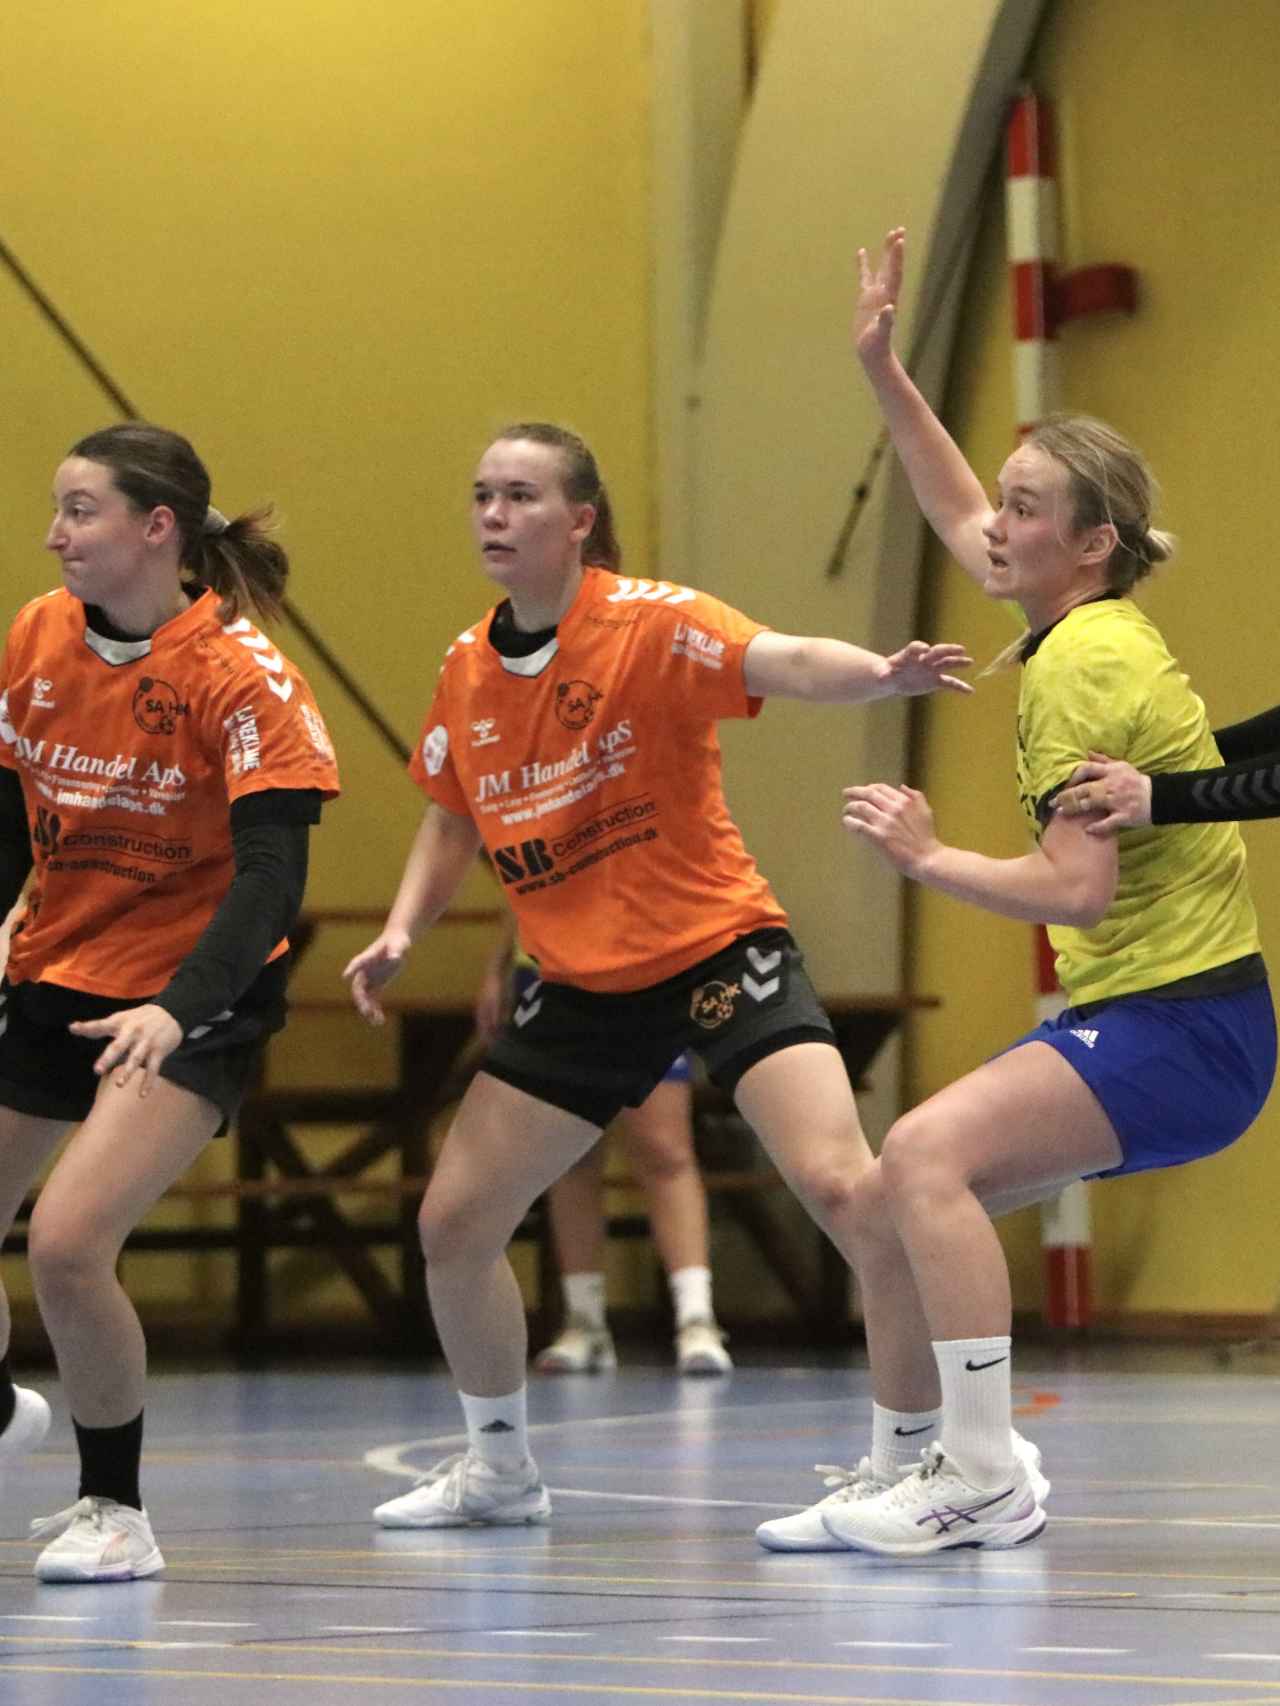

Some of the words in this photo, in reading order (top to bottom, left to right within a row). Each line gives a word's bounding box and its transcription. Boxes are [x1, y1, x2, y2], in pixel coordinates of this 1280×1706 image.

[49, 742, 138, 781] Handel
[474, 770, 513, 803] JM
[520, 740, 590, 790] Handel
